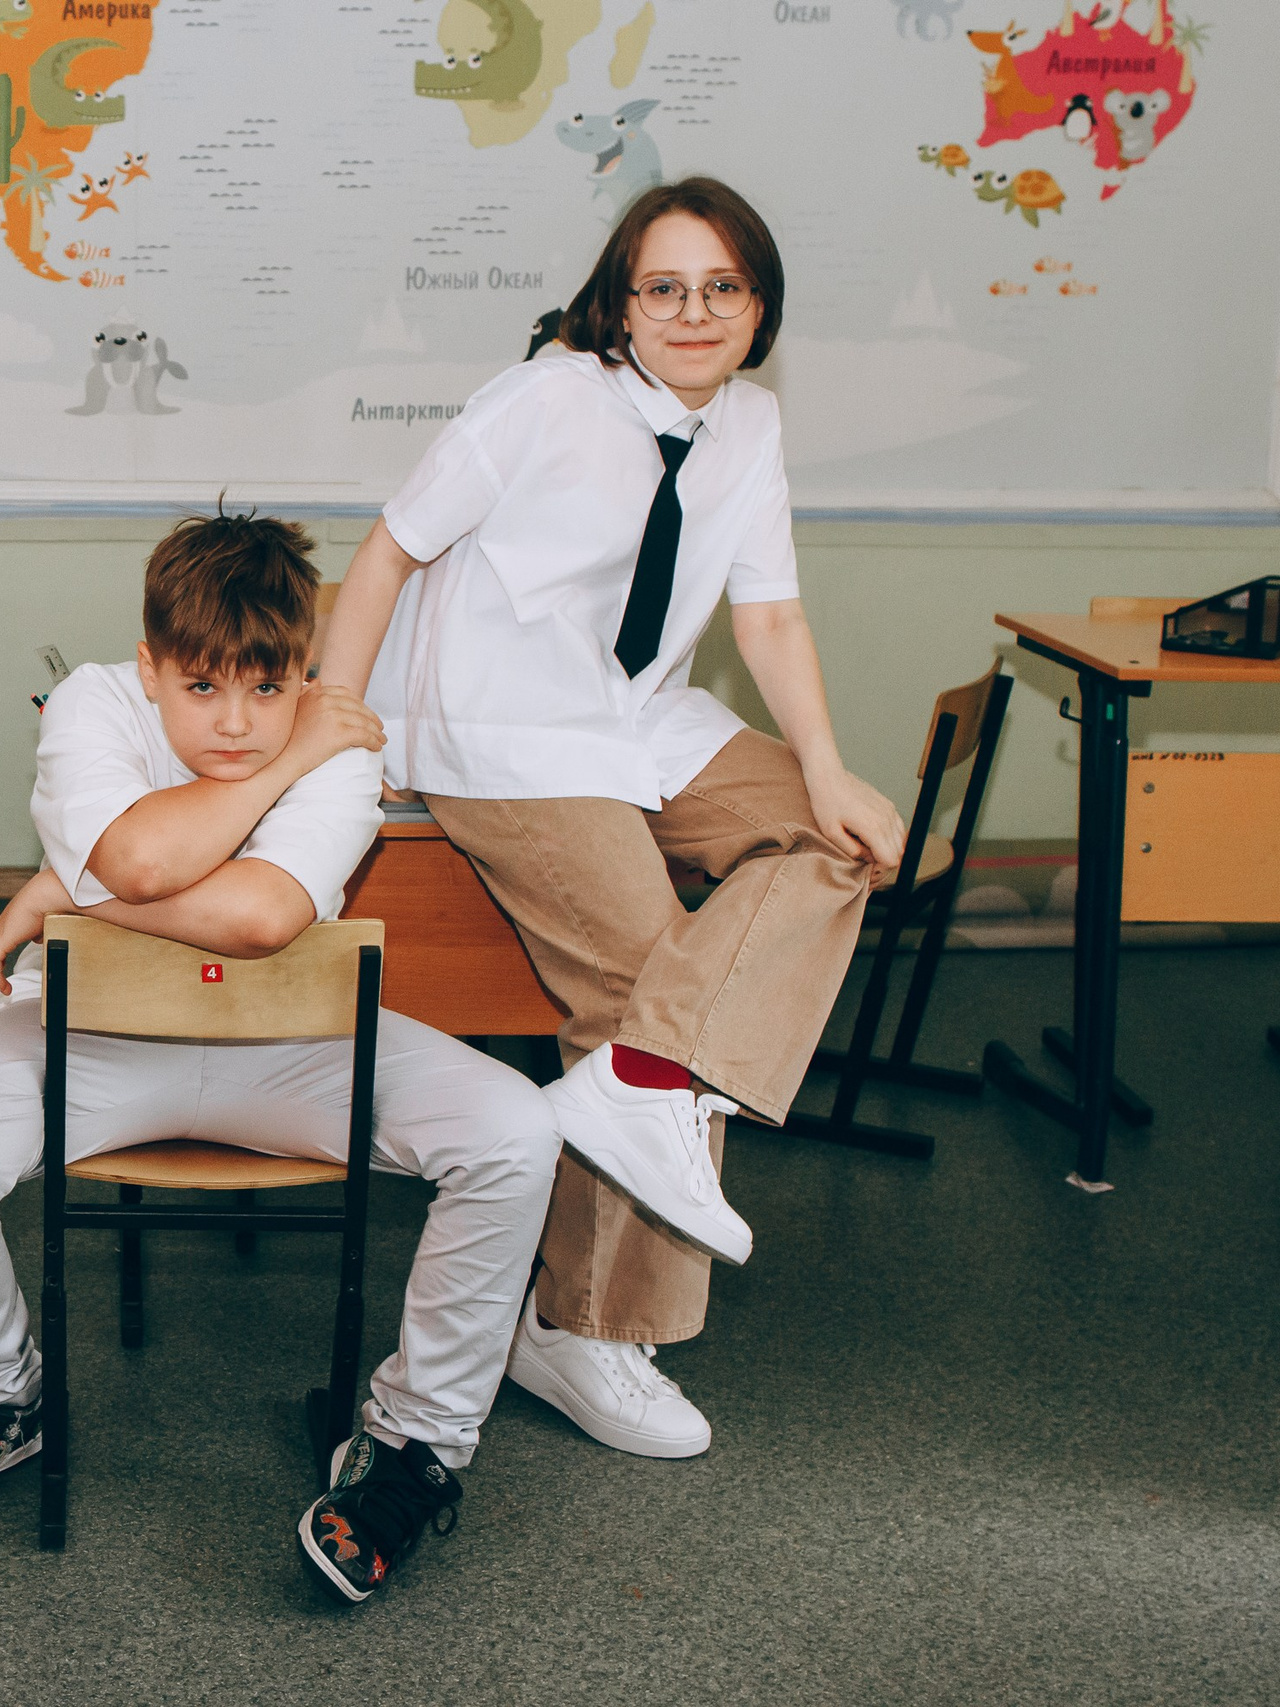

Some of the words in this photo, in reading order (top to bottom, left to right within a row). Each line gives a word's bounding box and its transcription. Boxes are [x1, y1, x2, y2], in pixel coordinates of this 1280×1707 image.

[62, 0, 151, 27] Америка
[1046, 50, 1157, 80] Австралия
[351, 397, 467, 428] Антаркти
